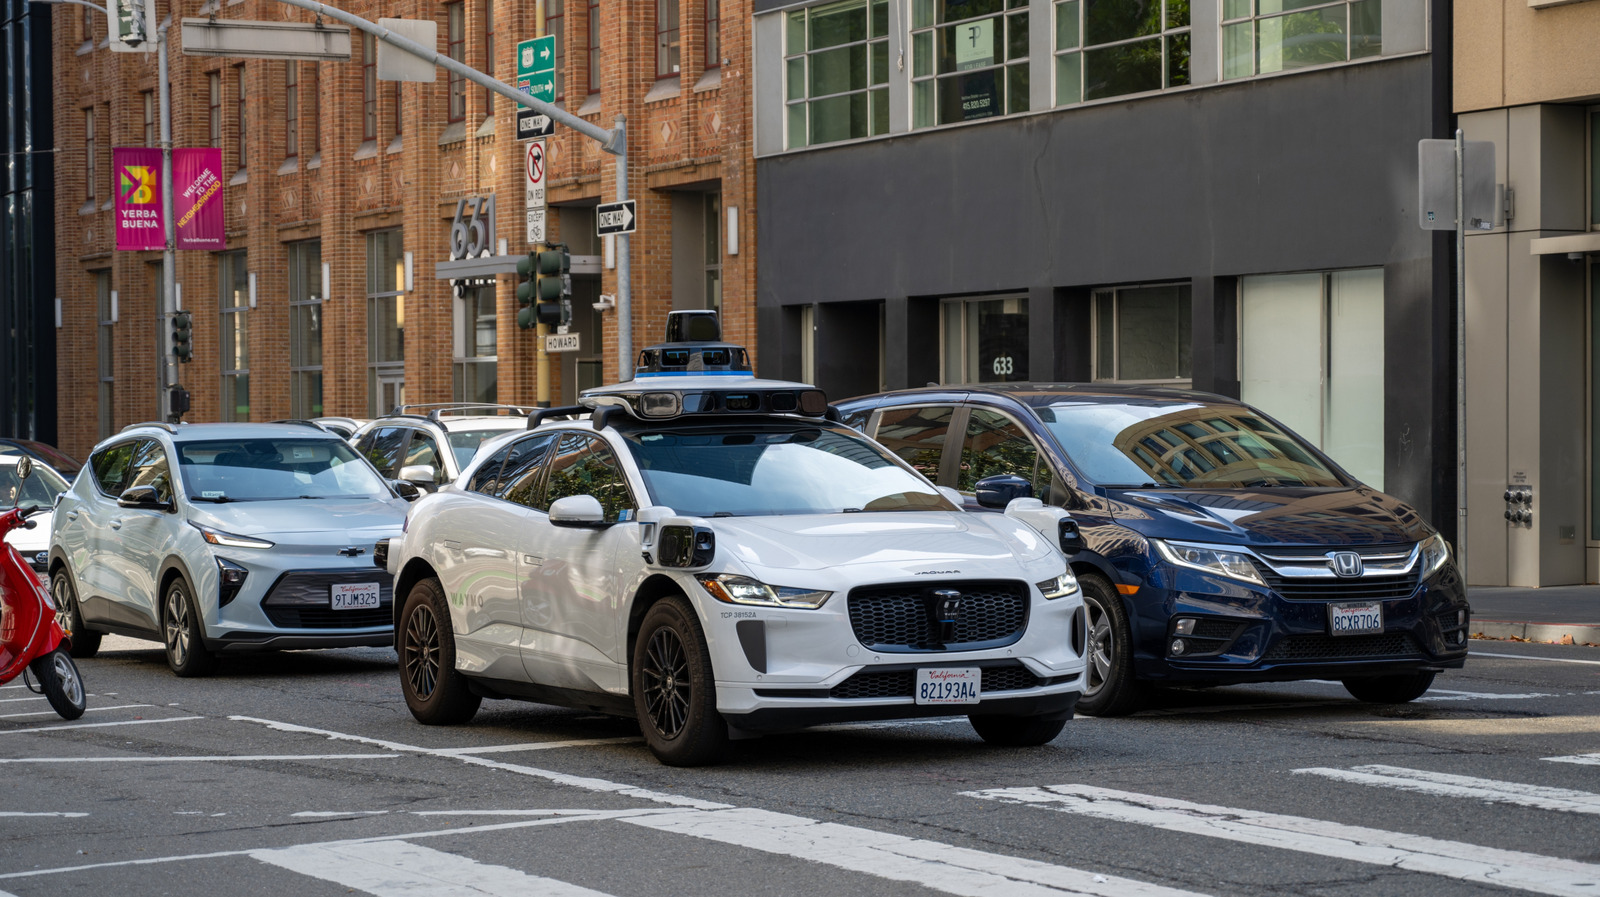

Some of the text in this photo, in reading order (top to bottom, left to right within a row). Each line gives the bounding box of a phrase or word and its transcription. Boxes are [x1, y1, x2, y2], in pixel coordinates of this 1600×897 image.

[530, 83, 544, 95] SOUTH
[521, 116, 543, 130] ONE WAY
[182, 167, 212, 198] WELCOME
[195, 173, 217, 196] TO THE
[527, 188, 544, 201] ON RED
[176, 180, 222, 229] NEIGHBORHOOD
[121, 209, 158, 218] YERBA
[528, 213, 544, 223] EXCEPT
[600, 210, 624, 227] ONE WAY
[122, 219, 159, 228] BUENA
[548, 336, 577, 348] HOWARD
[993, 356, 1013, 375] 633
[341, 585, 371, 593] California
[335, 592, 377, 606] 9TJM325
[450, 592, 484, 608] WAYMO
[1334, 613, 1379, 630] 8CXR706
[930, 670, 969, 681] California
[920, 681, 976, 699] 82193A4
